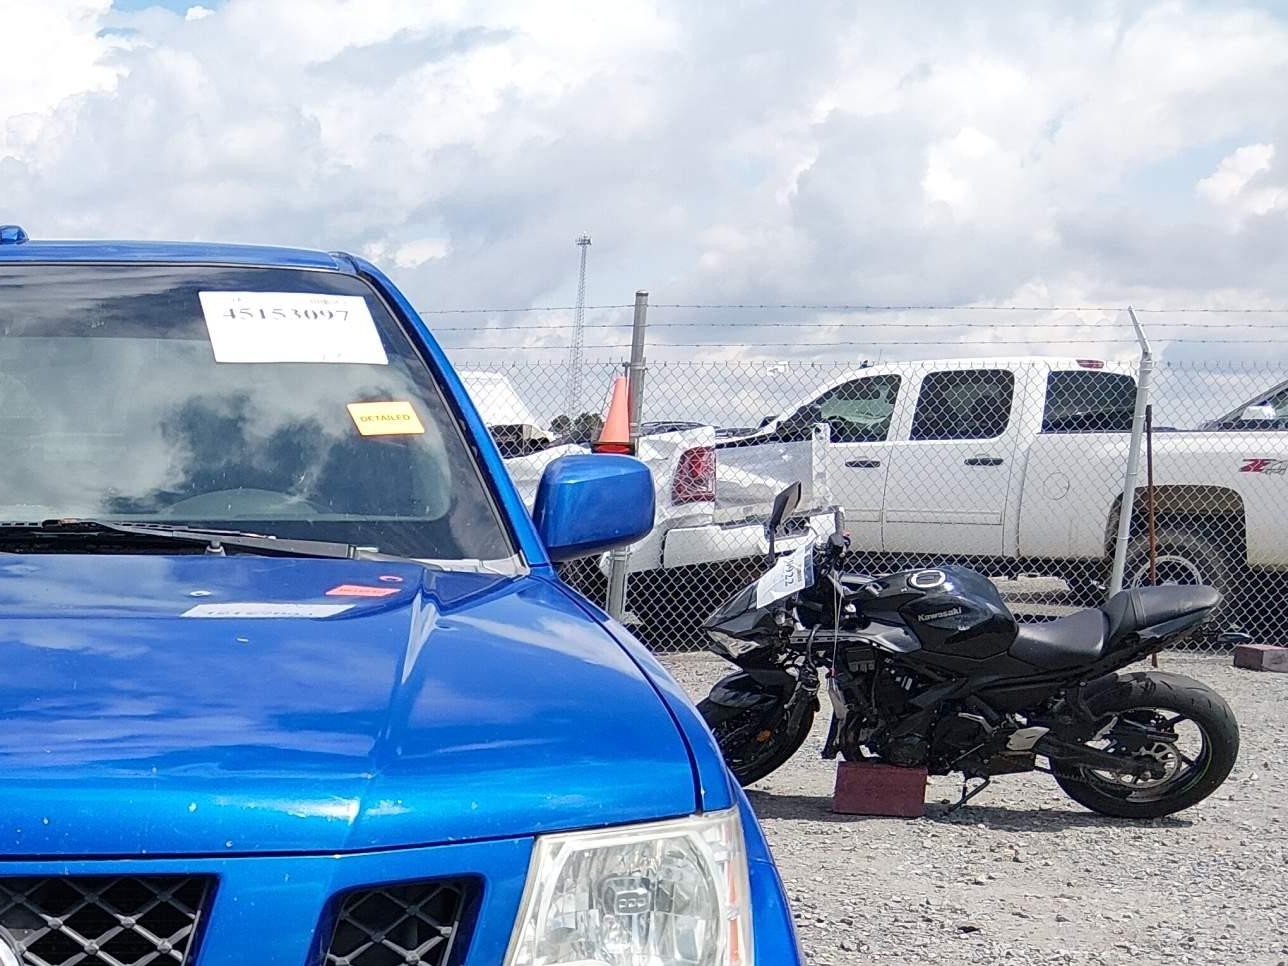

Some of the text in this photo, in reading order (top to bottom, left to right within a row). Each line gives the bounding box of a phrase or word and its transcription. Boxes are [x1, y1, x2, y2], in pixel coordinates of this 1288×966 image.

[223, 308, 349, 321] 45153097
[359, 414, 410, 423] DETAILED
[917, 606, 963, 623] Kawasaki
